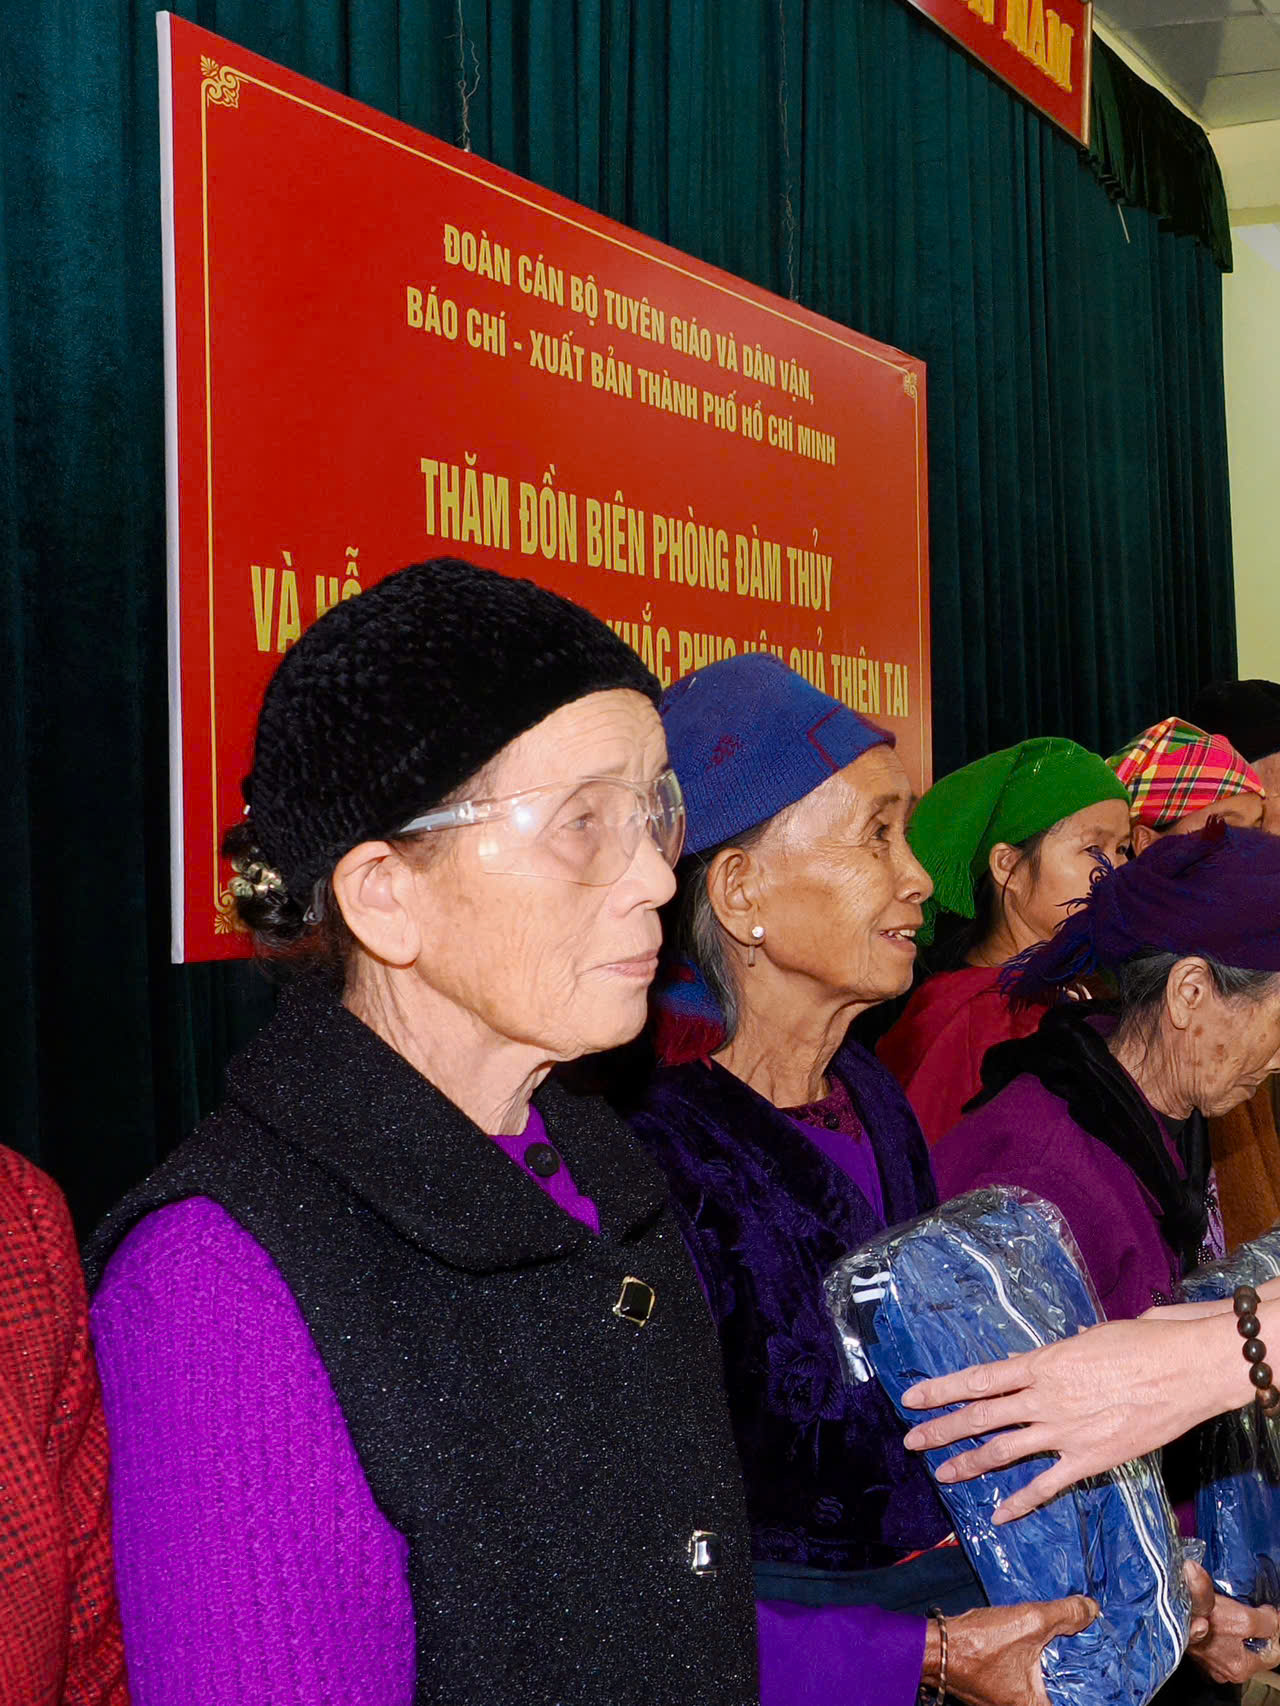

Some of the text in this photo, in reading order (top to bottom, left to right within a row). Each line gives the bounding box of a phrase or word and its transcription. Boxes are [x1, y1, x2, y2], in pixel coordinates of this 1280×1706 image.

[406, 285, 459, 342] BÁO
[466, 307, 507, 358] CHÍ
[513, 341, 523, 351] -
[529, 329, 585, 384] XUẤT
[591, 345, 633, 400] BẢN
[637, 368, 698, 421] THÀNH
[703, 390, 737, 433] PHỐ
[768, 414, 793, 452] CHÍ
[797, 424, 836, 466] MINH
[443, 223, 815, 406] ĐOÀN CÁN BỘ TUYÊN GIÁO VÀ DÂN VẬN,
[420, 451, 833, 613] THĂM ĐỒN BIÊN PHÒNG ĐÀM THỦY
[250, 550, 301, 654] VÀ
[830, 645, 881, 715] THIÊN
[884, 662, 909, 718] TAI
